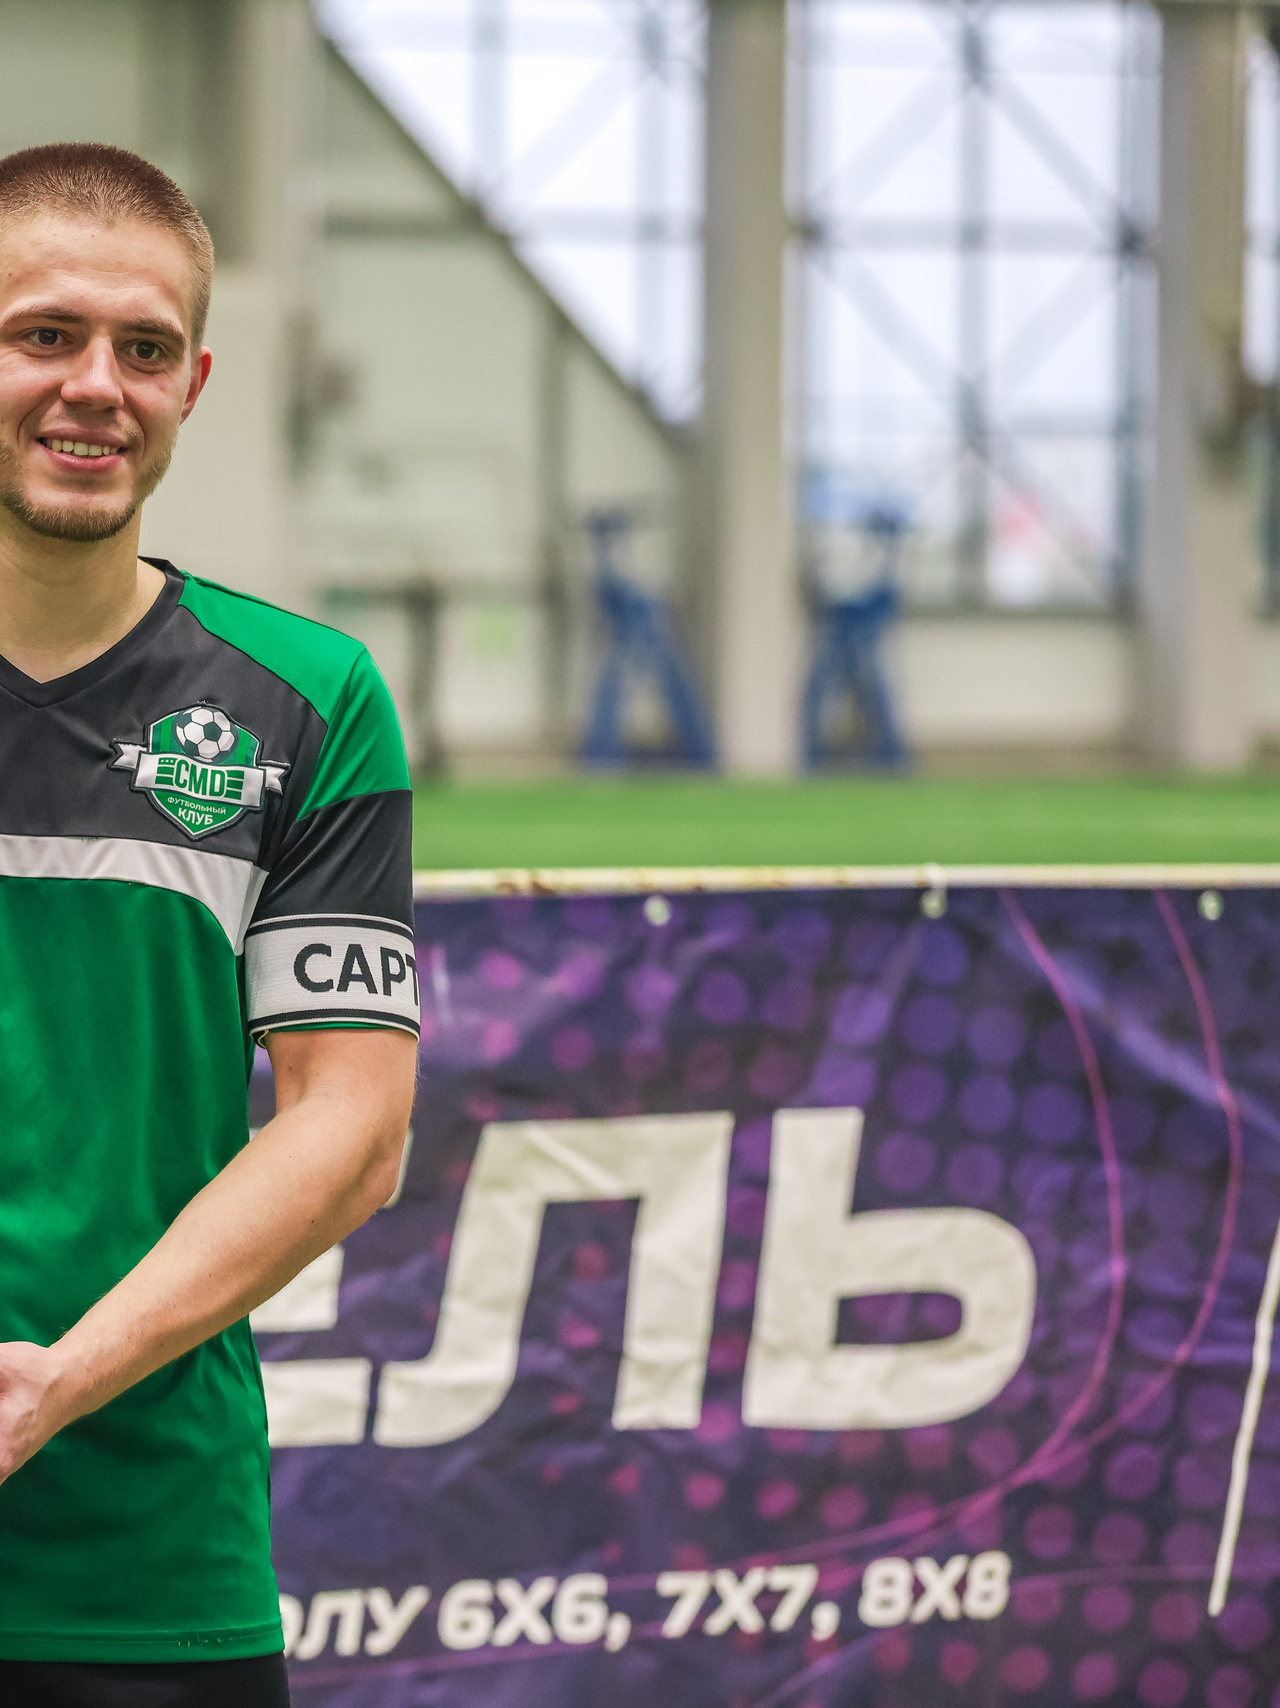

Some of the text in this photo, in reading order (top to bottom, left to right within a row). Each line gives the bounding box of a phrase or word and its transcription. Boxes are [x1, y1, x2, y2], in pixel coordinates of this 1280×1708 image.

[174, 758, 226, 797] CMD
[167, 797, 227, 815] ФУТБОЛЬНЫЙ
[178, 808, 214, 826] КЛУБ
